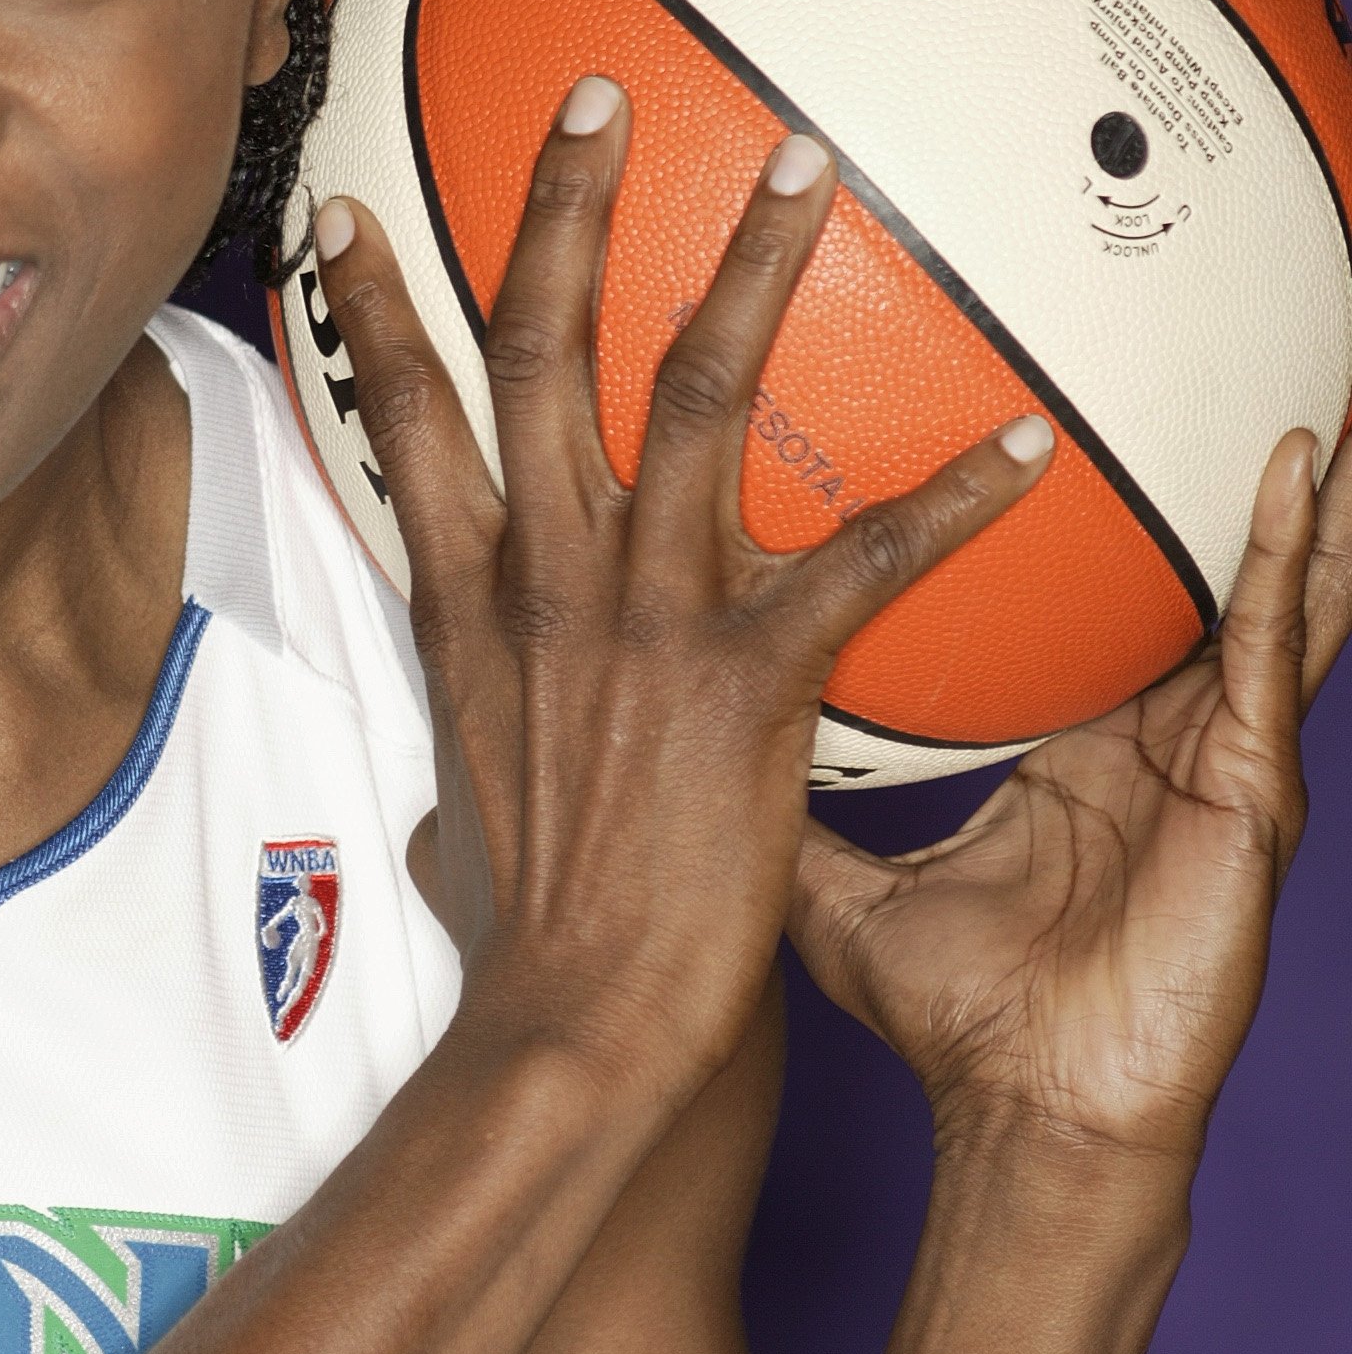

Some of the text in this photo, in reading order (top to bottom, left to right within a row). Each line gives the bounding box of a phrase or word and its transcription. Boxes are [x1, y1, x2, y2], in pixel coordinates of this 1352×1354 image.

[1113, 0, 1229, 128] Keep Pump Locked
[1132, 36, 1168, 74] Avoid
[1170, 37, 1202, 75] When
[1090, 21, 1215, 163] Press Down On Pump
[1099, 53, 1189, 154] To Deflate Ball
[1171, 76, 1186, 95] To
[1204, 75, 1244, 125] Except
[1187, 96, 1233, 154] Caution:
[1115, 214, 1150, 227] LOCK
[1102, 241, 1159, 257] UNLOCK
[266, 848, 336, 872] WNBA
